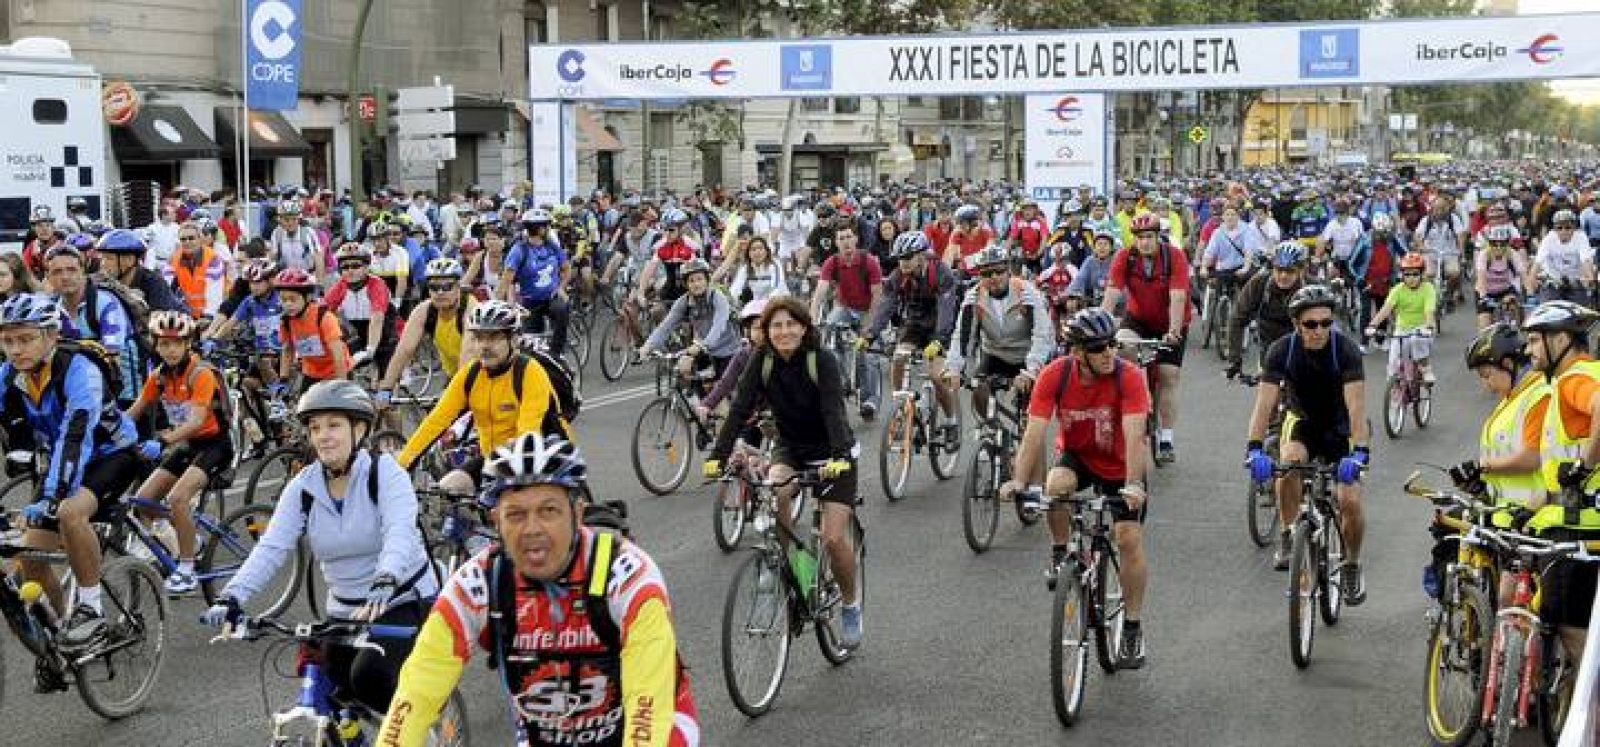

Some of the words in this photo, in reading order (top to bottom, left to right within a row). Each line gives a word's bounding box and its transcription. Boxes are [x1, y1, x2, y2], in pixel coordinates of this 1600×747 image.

[889, 46, 943, 81] XXXI
[950, 44, 1029, 80] FIESTA
[1036, 43, 1067, 78] DE
[1075, 41, 1105, 76] LA
[1113, 37, 1240, 76] BICICLETA
[1416, 40, 1508, 62] iberCaja
[252, 63, 295, 83] COPE
[619, 63, 692, 82] iberCaja
